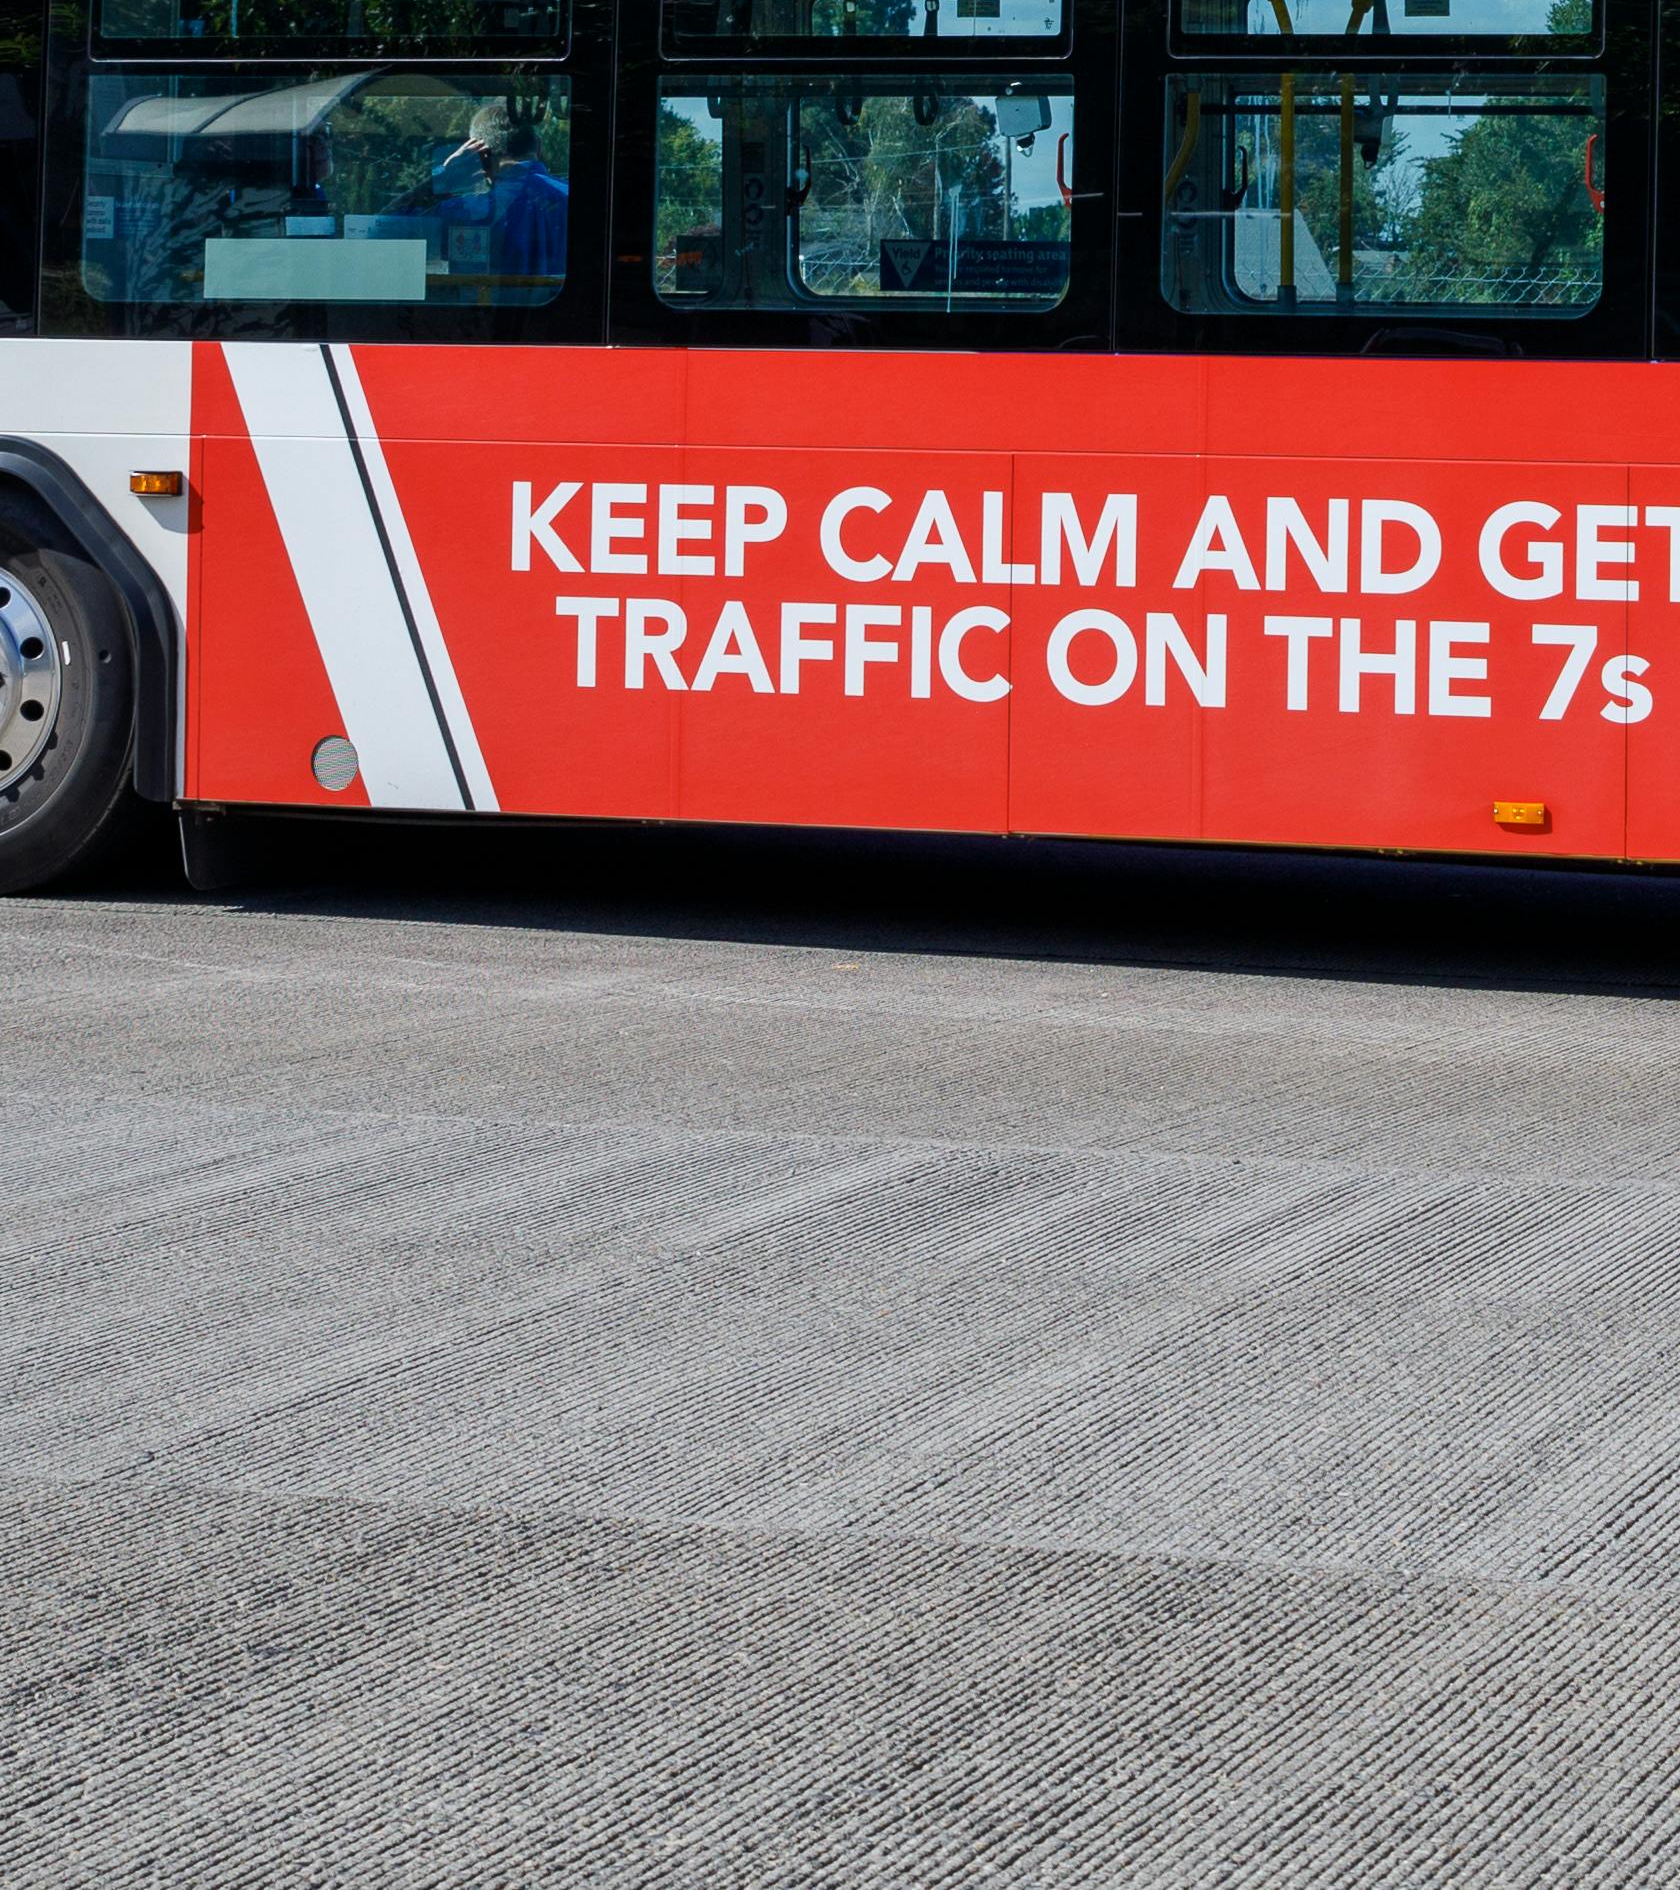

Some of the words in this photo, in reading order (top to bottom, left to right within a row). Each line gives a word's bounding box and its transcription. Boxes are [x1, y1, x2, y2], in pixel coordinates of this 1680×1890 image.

[933, 246, 984, 263] Prrity
[986, 247, 1034, 264] seating
[1038, 250, 1066, 261] area
[511, 480, 788, 578] KEEP
[819, 486, 1138, 588] CALM
[1172, 494, 1442, 595] AND
[555, 595, 1014, 703] TRAFFIC
[1046, 608, 1228, 708] ON
[1263, 615, 1492, 718] THE
[1531, 623, 1654, 724] 7s
